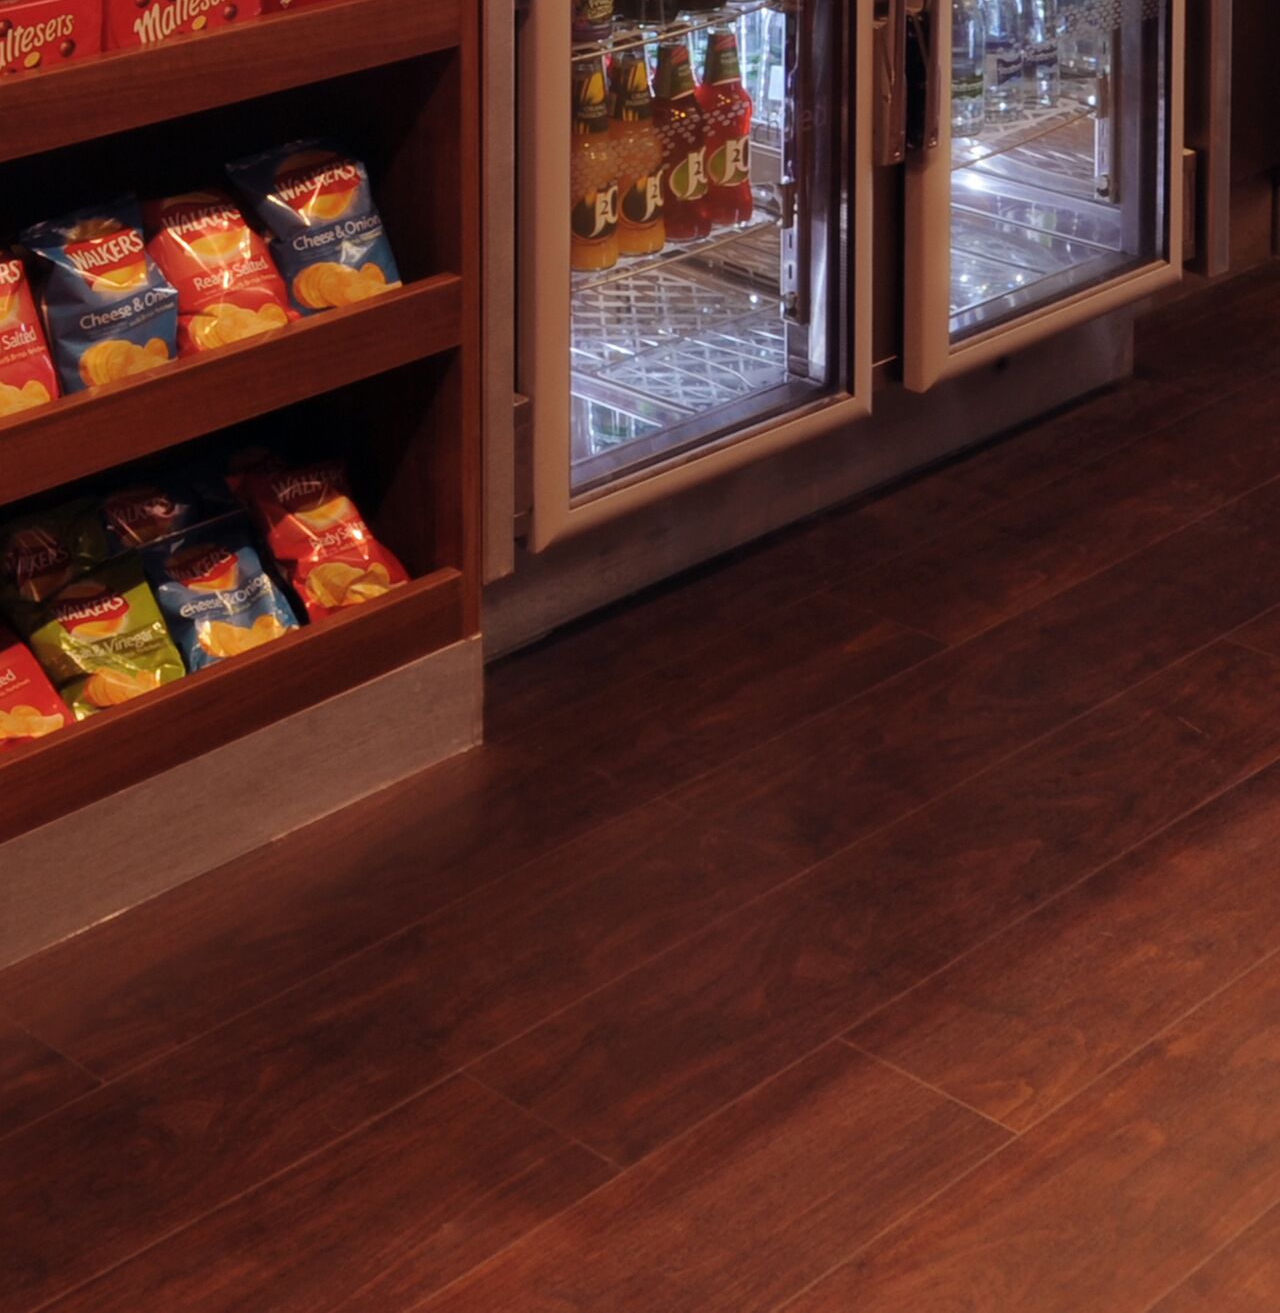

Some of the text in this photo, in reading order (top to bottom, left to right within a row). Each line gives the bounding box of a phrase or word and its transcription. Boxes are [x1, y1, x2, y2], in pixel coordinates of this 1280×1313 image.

[274, 161, 357, 202] WALKERS
[292, 214, 381, 252] Cheese & Onion
[65, 229, 145, 272] WALKERS
[232, 254, 269, 279] Salted
[80, 305, 133, 330] Cheese
[132, 297, 145, 313] &
[1, 323, 37, 351] Salted
[51, 592, 125, 625] WALKERS
[103, 628, 154, 656] Vinegar
